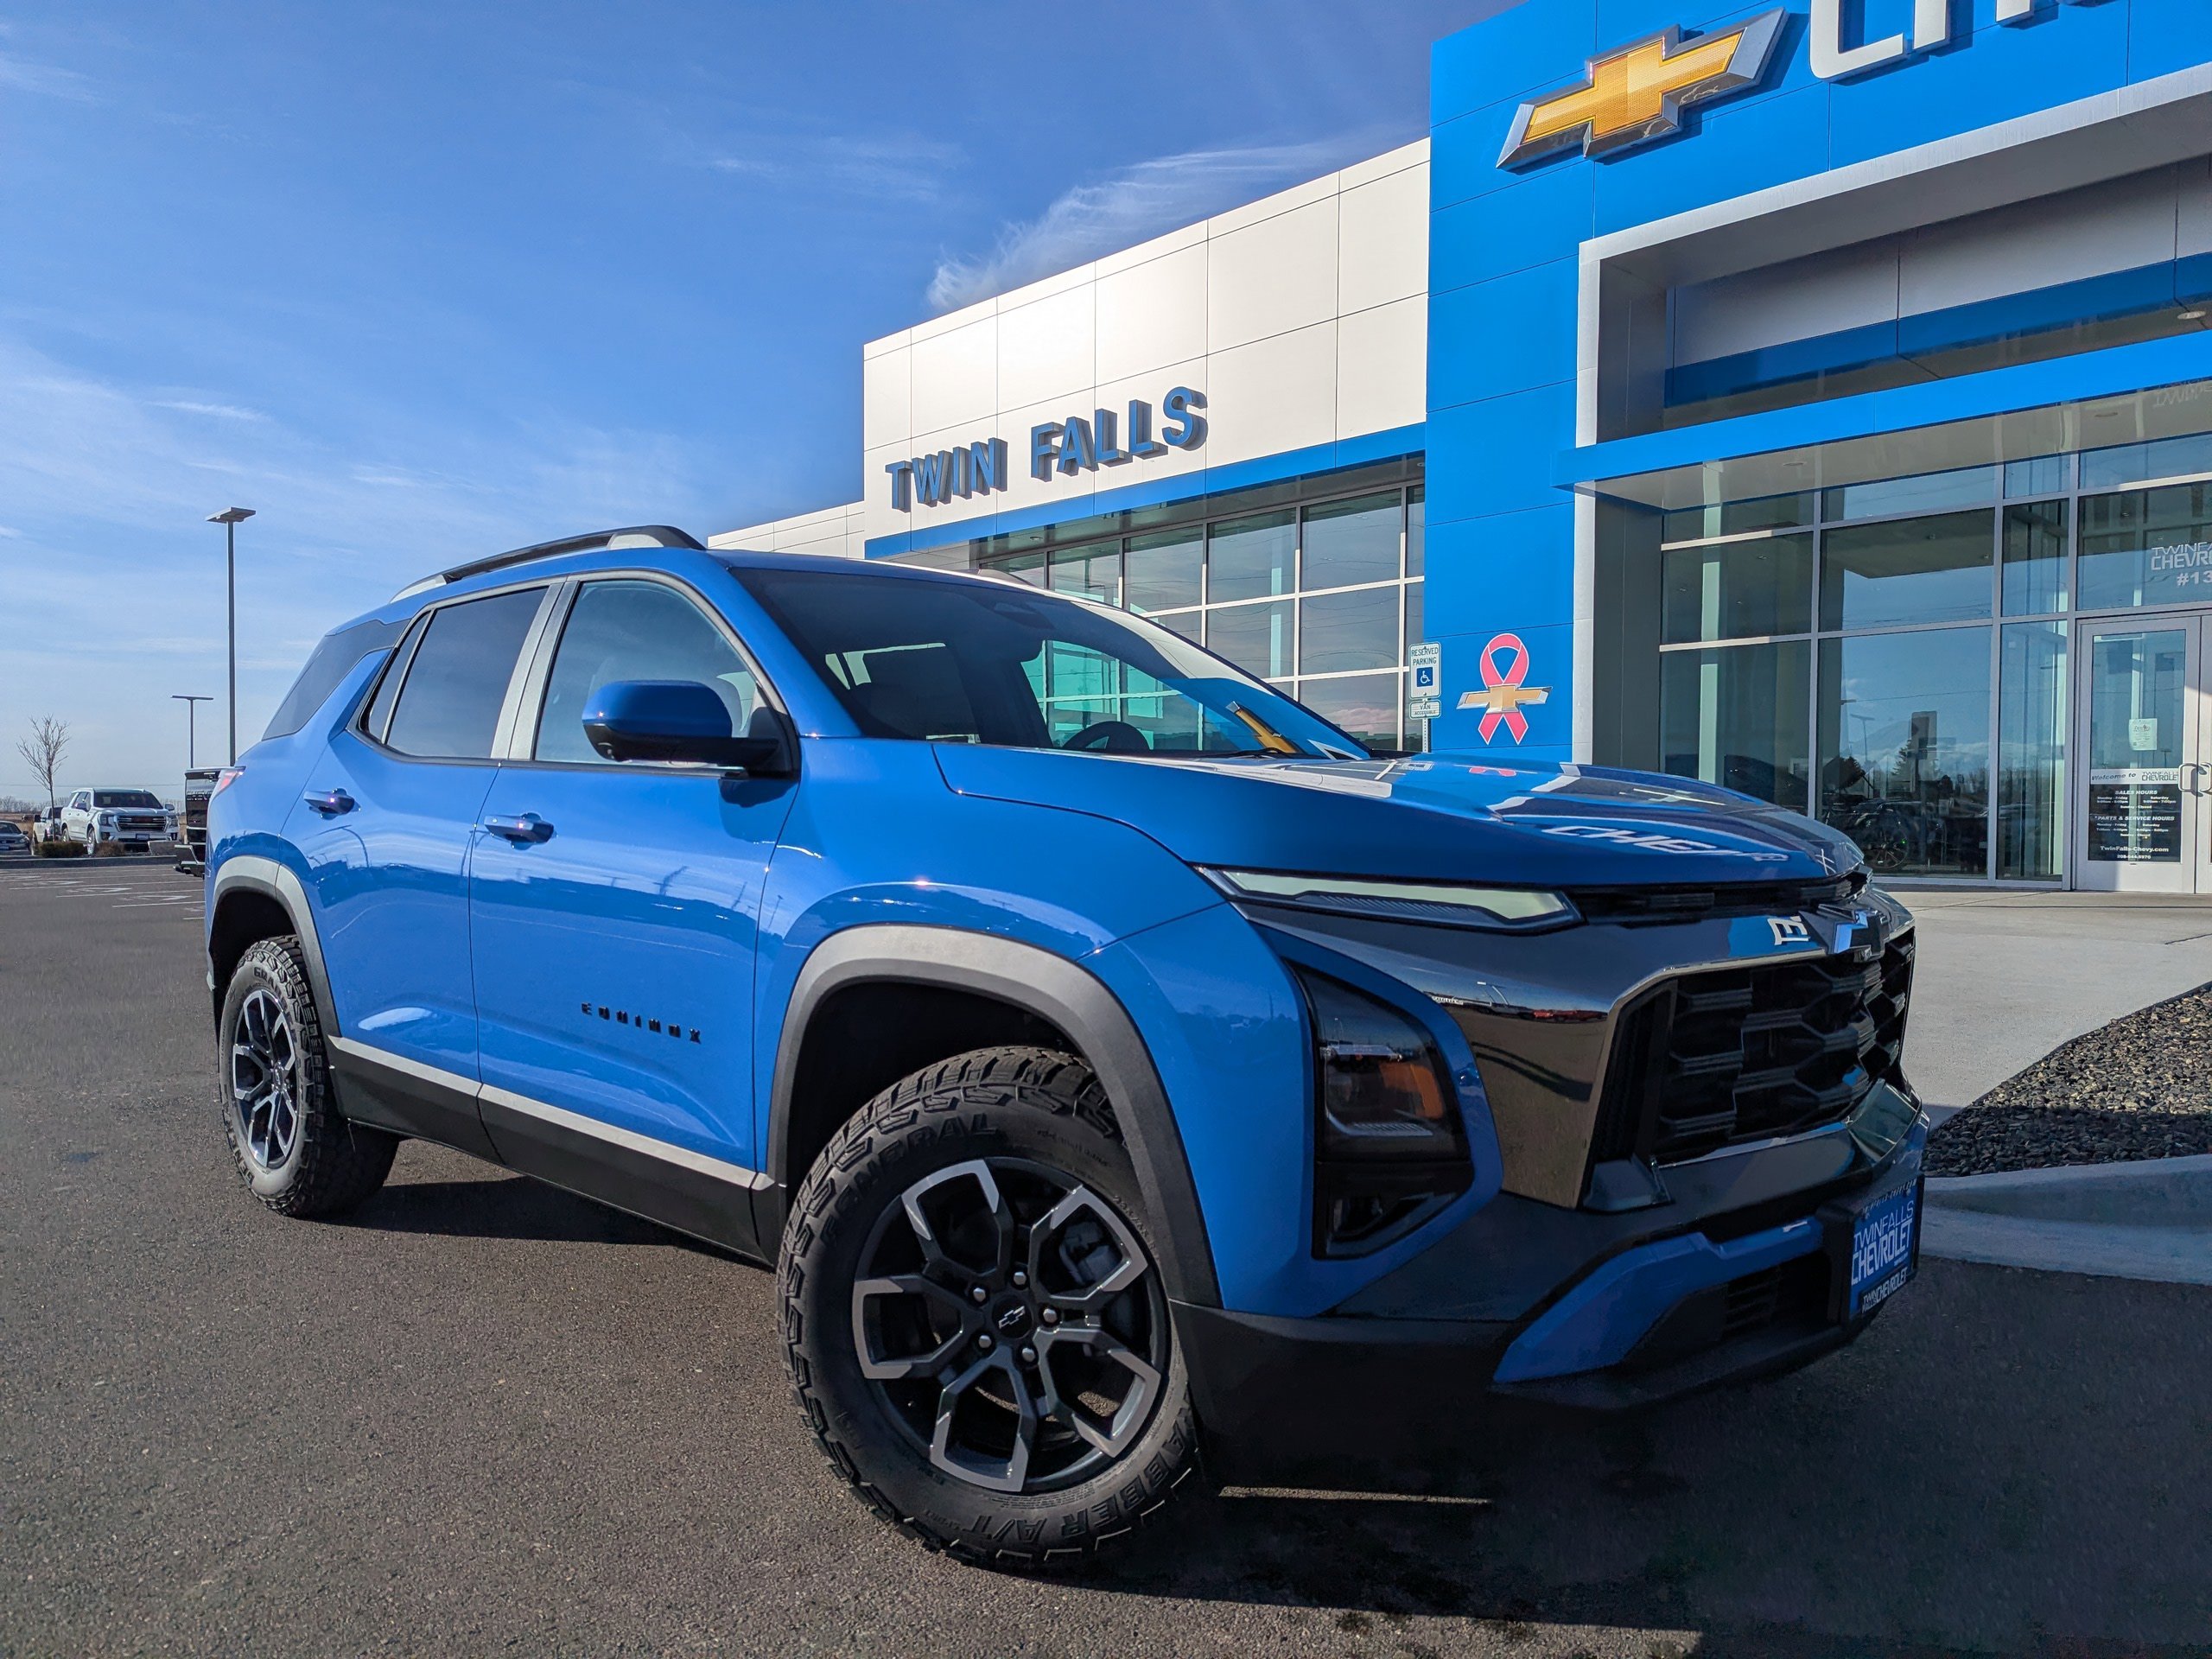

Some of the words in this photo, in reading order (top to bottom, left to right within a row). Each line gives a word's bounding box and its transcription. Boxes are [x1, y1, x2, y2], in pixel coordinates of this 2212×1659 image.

[885, 438, 1008, 513] TWIN
[1031, 386, 1209, 482] FALLS
[1411, 647, 1439, 657] RESERVED
[1413, 657, 1437, 665] PARKING
[818, 1112, 1000, 1246] GENERAL
[1853, 1199, 1915, 1249] TWINFALLS
[1851, 1217, 1914, 1287] CHEVROLET
[1876, 1266, 1909, 1304] CHEVROLET
